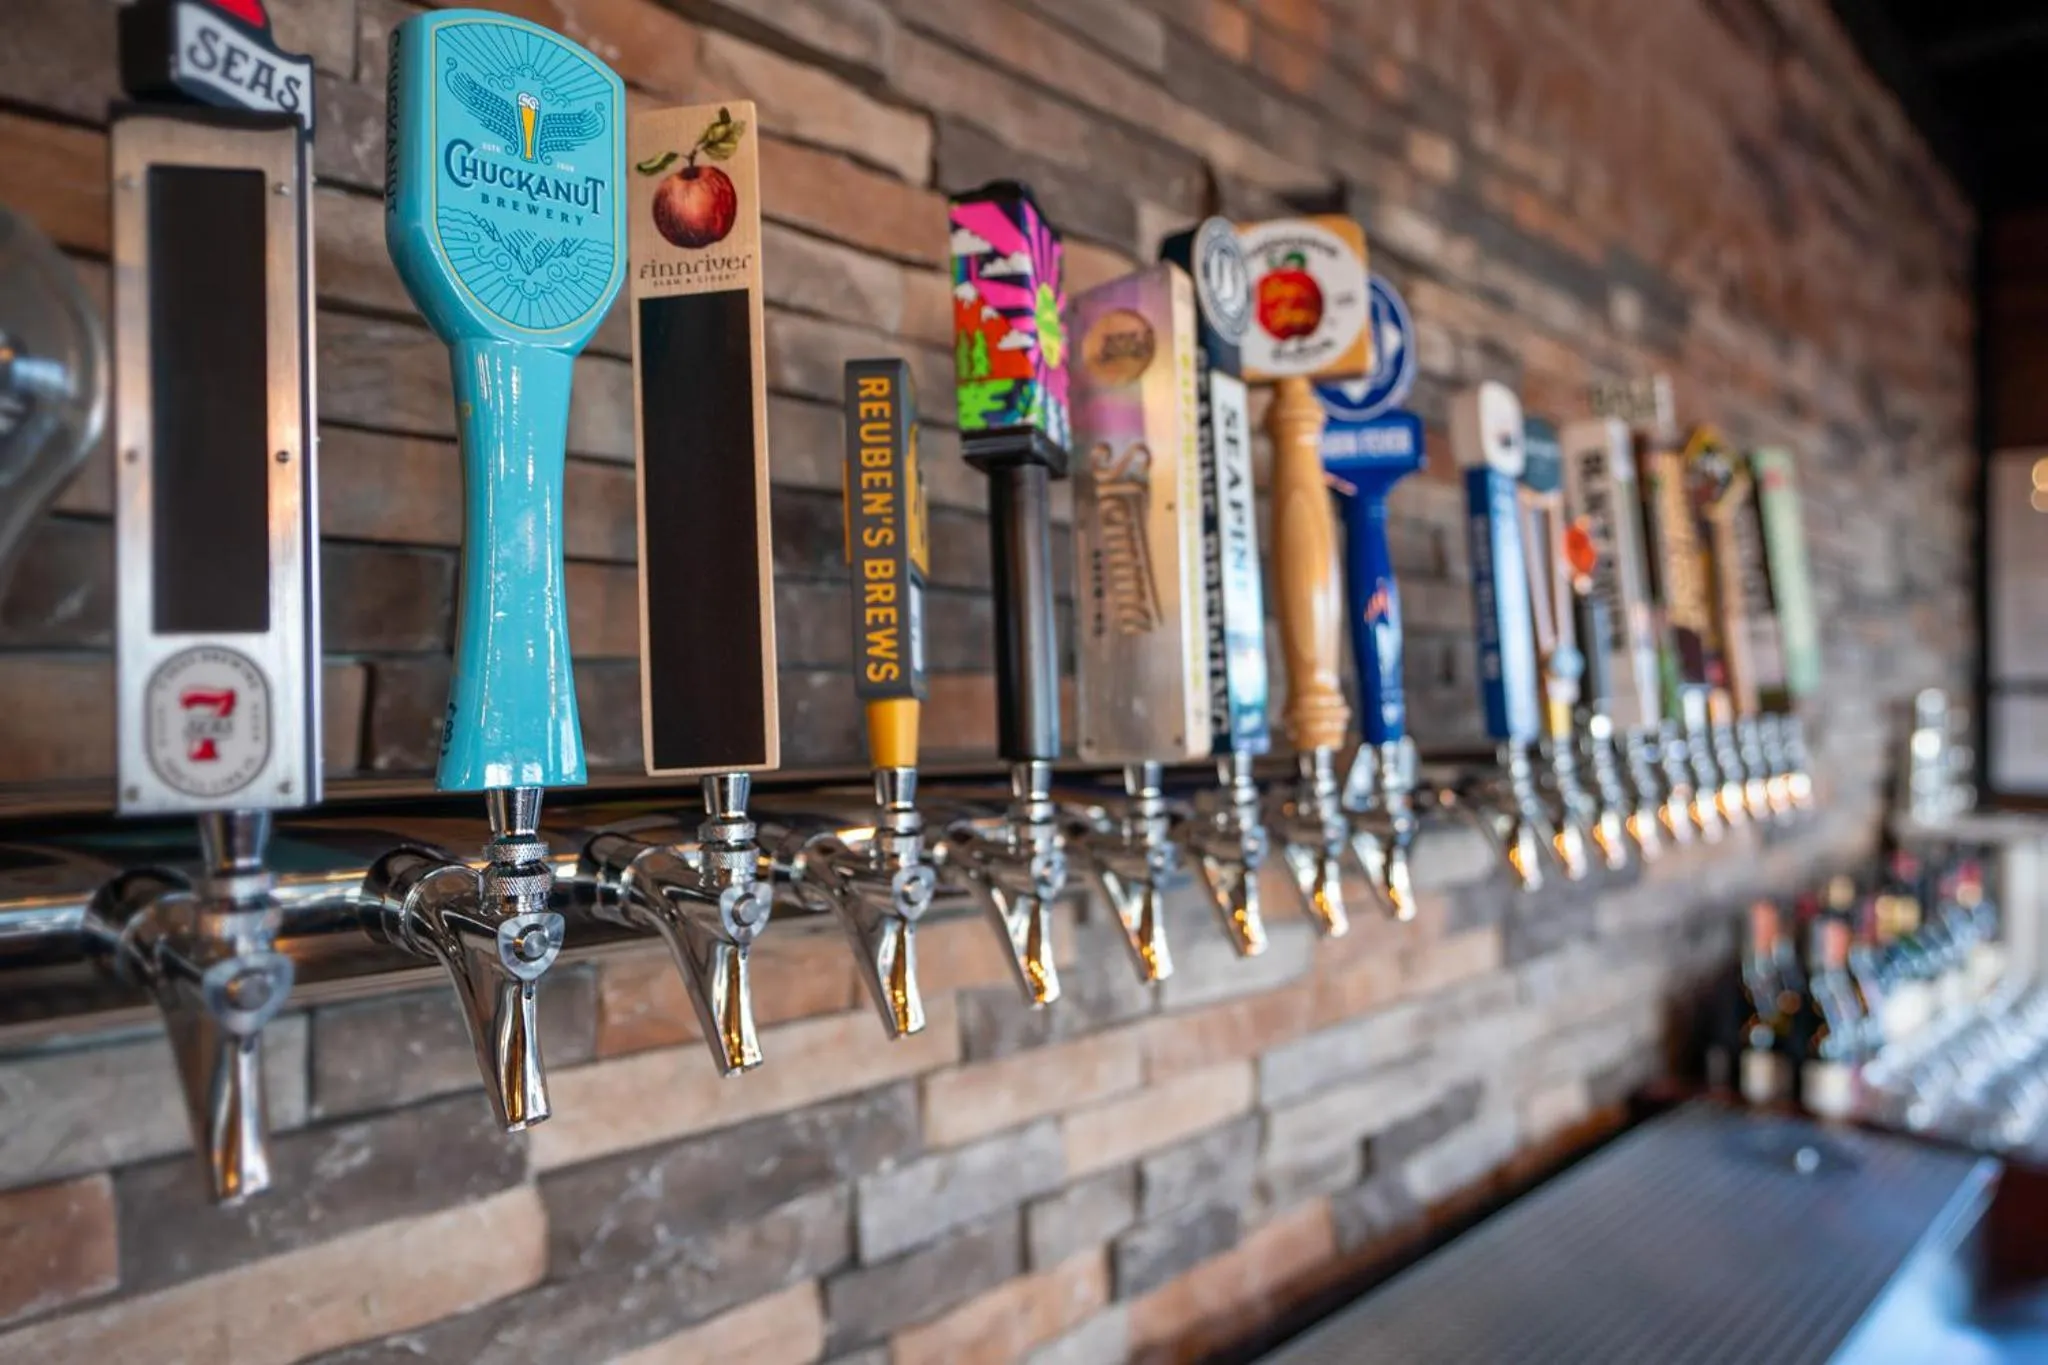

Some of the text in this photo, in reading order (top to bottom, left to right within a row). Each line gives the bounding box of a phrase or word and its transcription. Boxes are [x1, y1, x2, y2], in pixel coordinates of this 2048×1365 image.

[187, 25, 302, 113] SEAS
[445, 138, 606, 216] CHUCKANUT
[481, 192, 585, 227] BREWERY
[639, 253, 752, 280] finnriver
[857, 376, 900, 683] REUBEN'S BREWS
